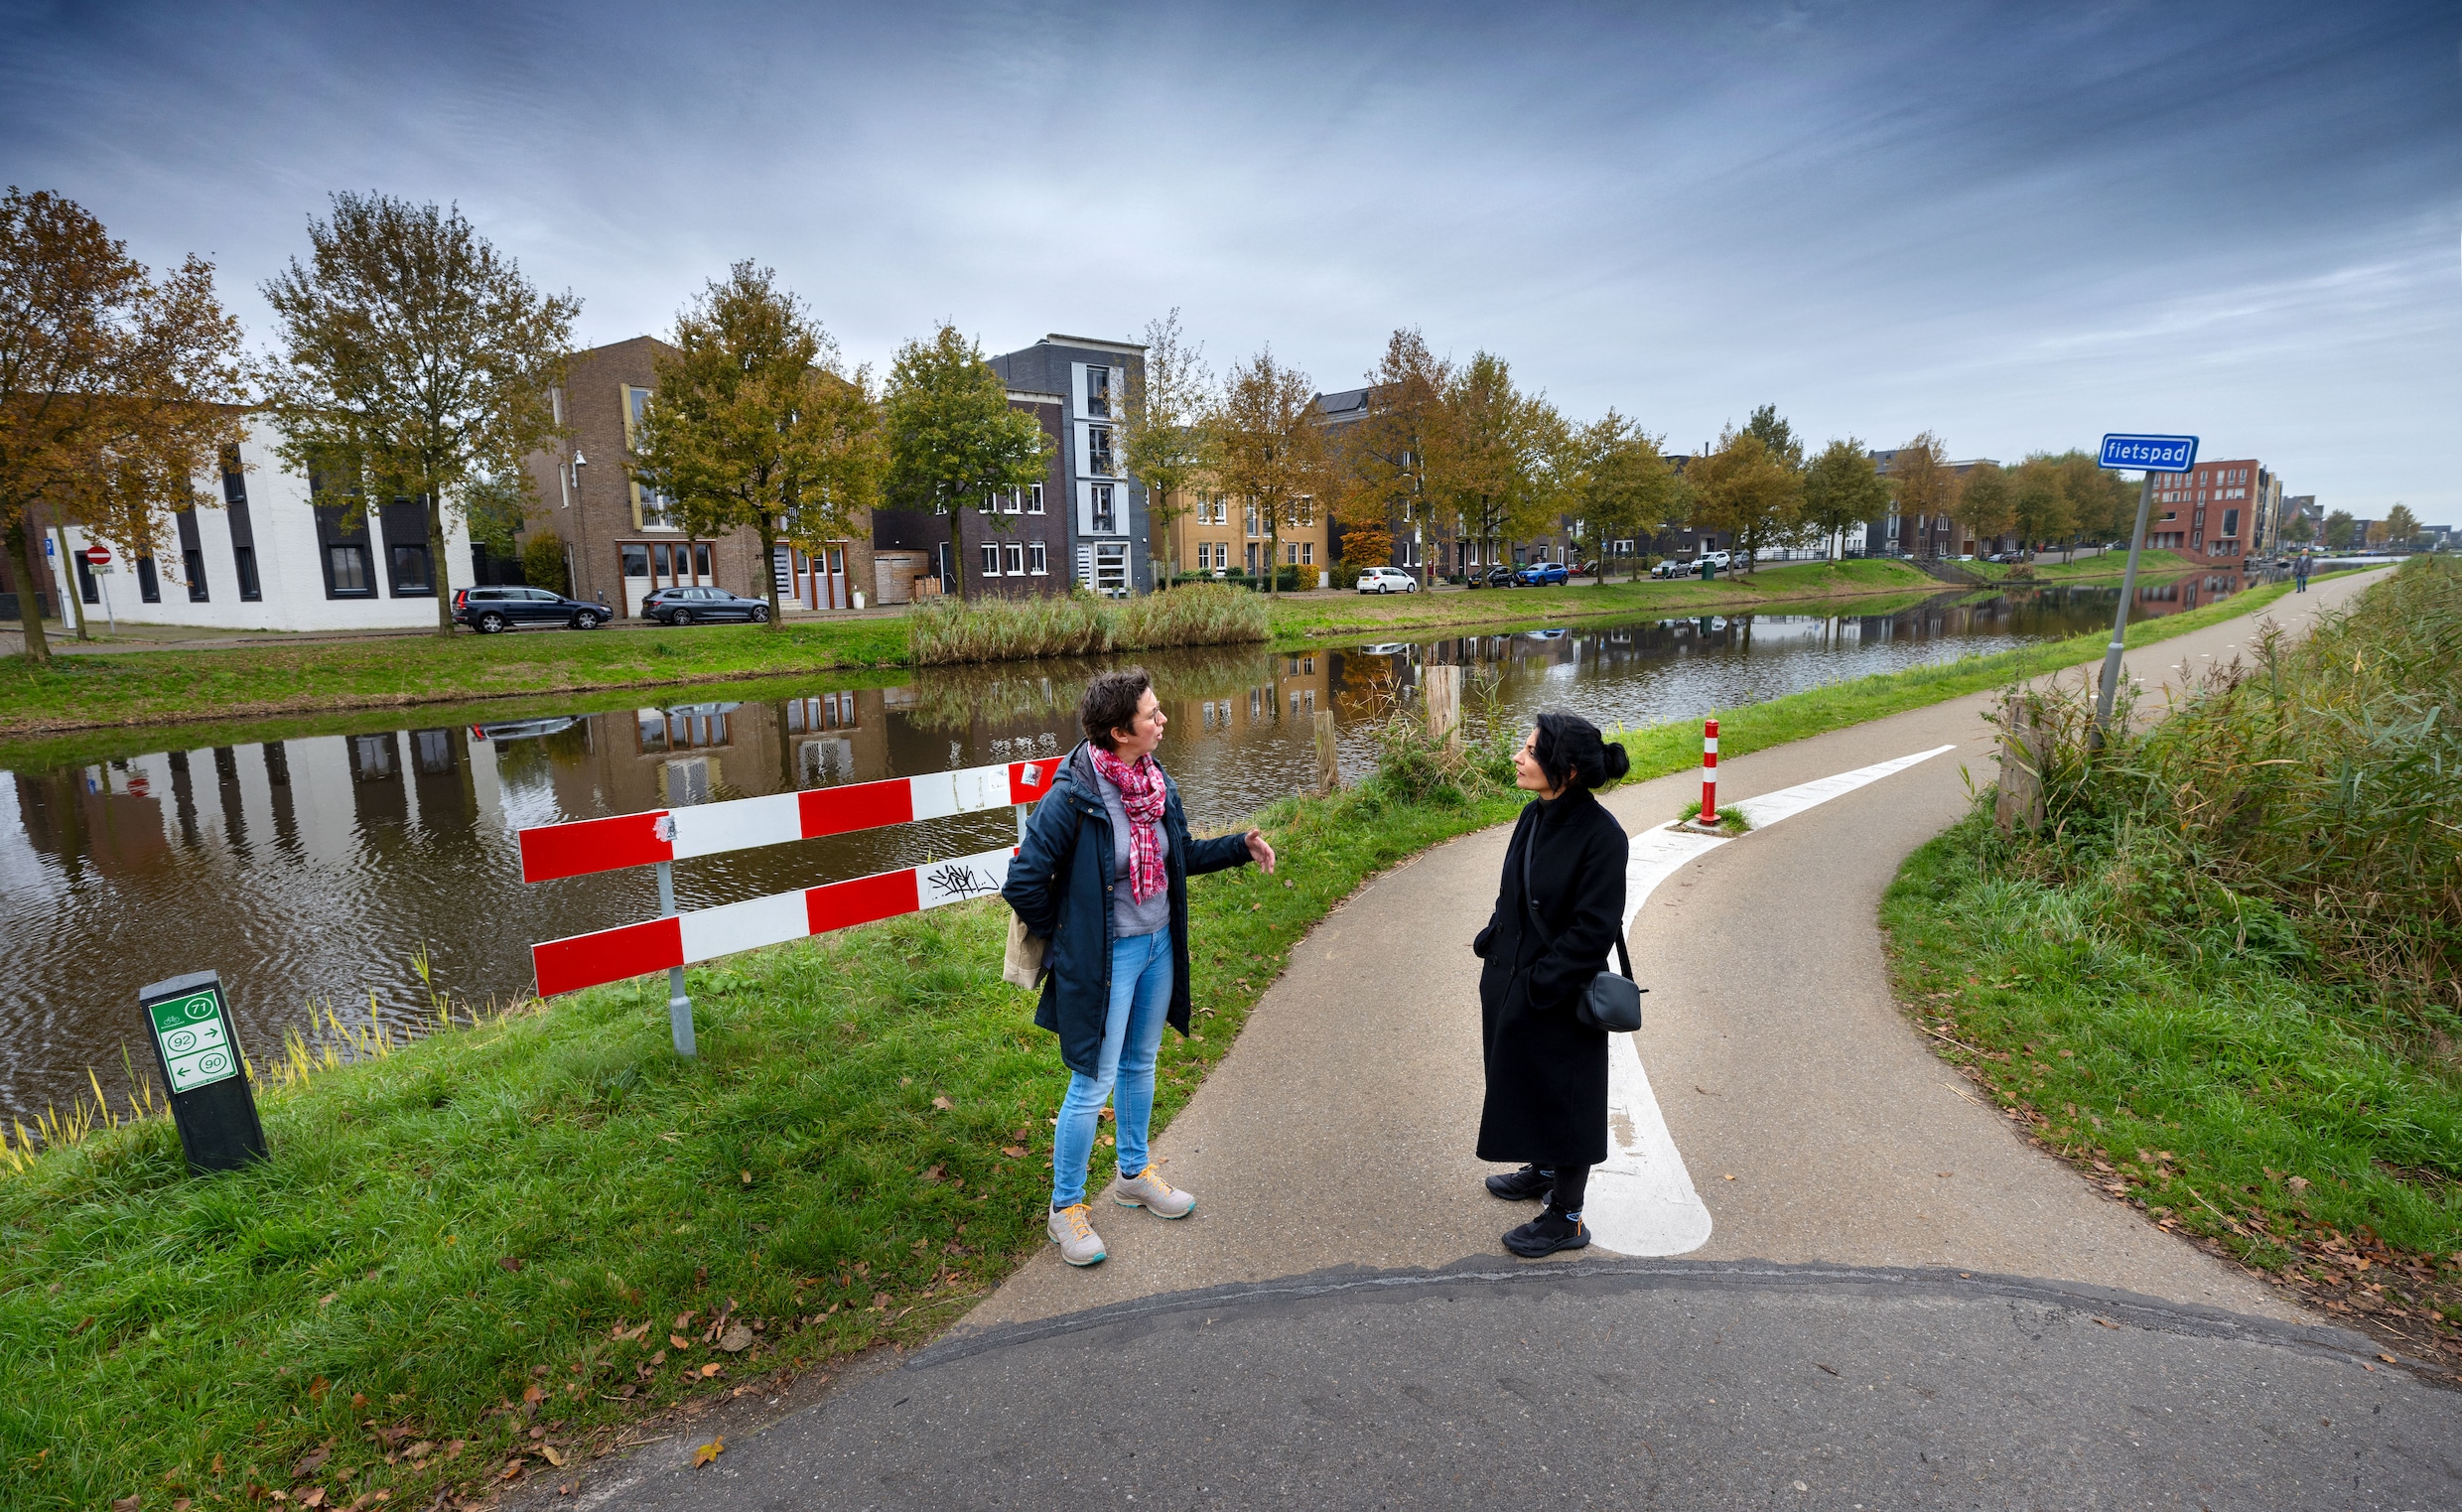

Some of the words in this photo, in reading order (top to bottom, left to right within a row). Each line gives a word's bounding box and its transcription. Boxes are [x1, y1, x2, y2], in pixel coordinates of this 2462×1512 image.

[2108, 443, 2186, 463] fietspad
[192, 1003, 206, 1014] 71
[174, 1035, 191, 1047] 92
[205, 1057, 221, 1069] 90
